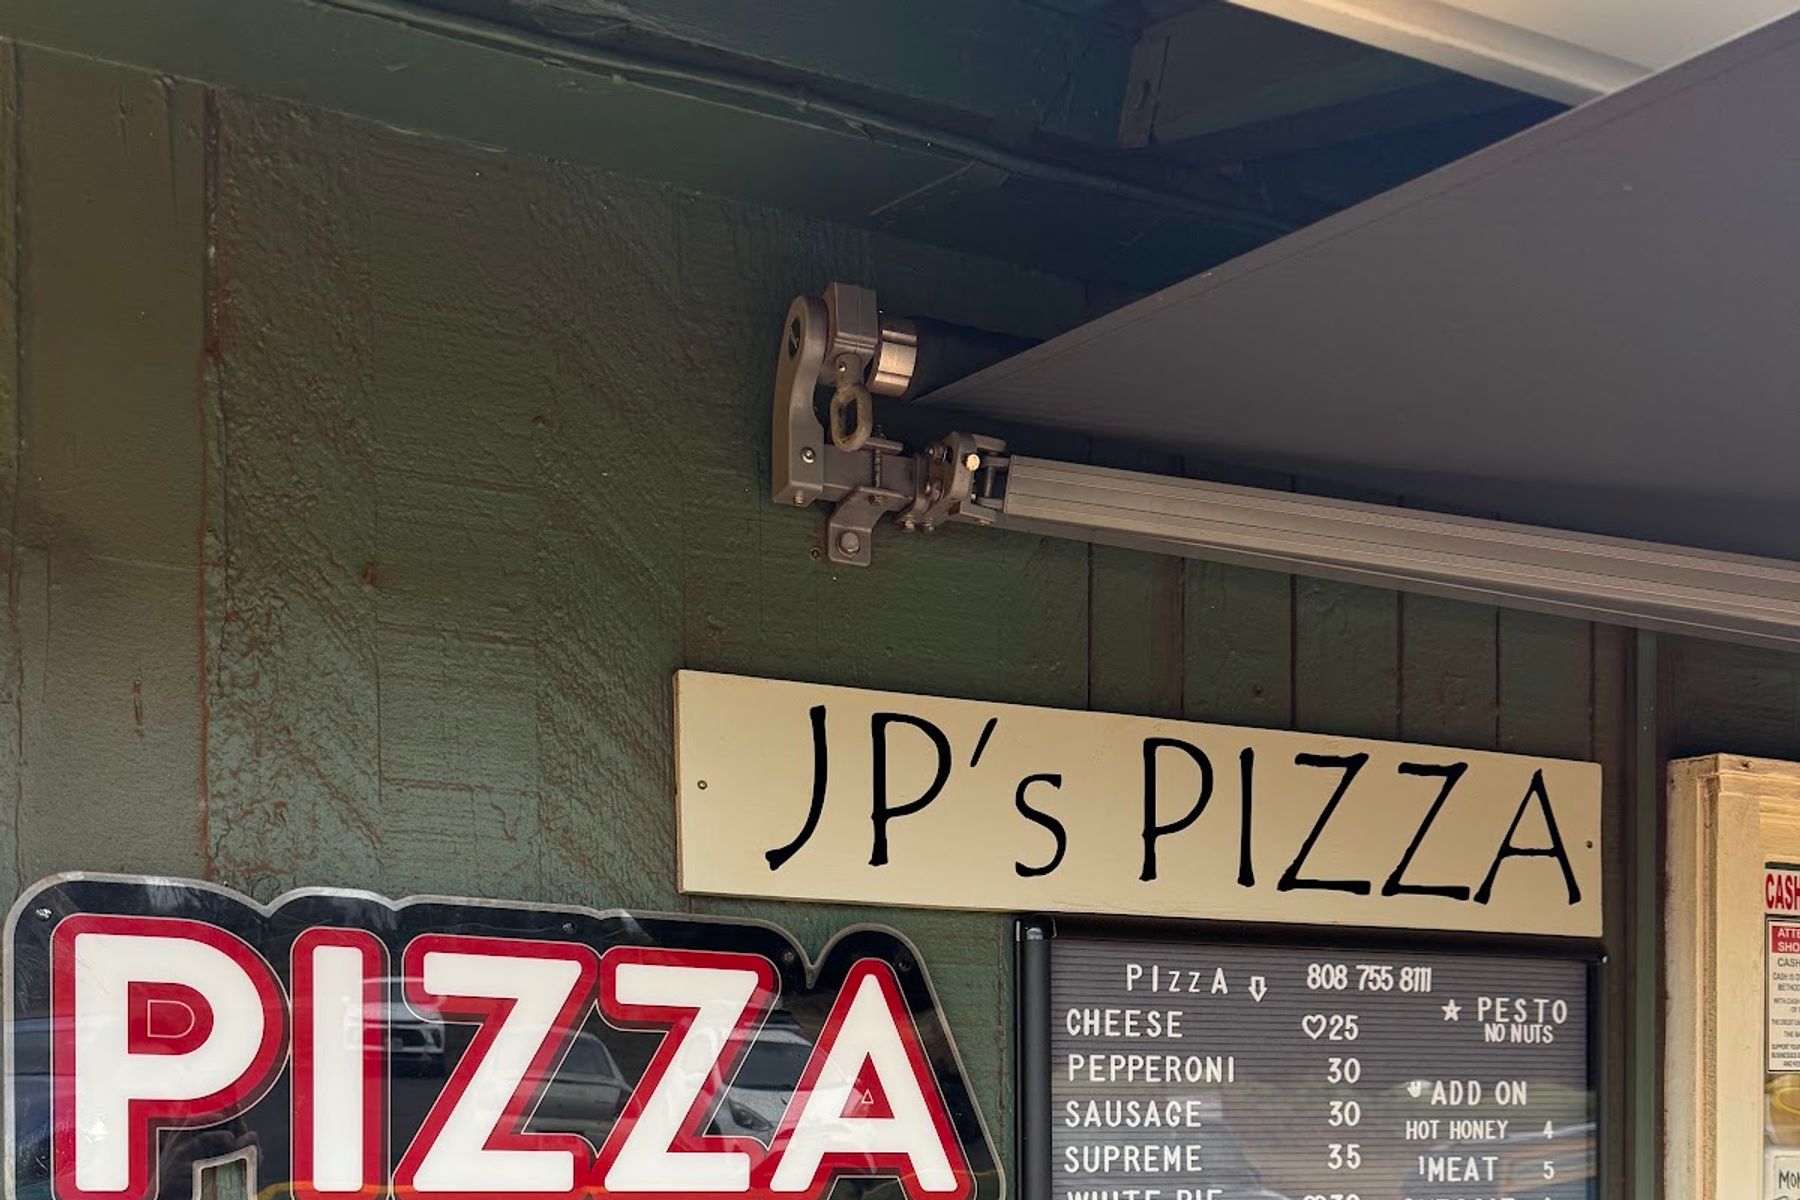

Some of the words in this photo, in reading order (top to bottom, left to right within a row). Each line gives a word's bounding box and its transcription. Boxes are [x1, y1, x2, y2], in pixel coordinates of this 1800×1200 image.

[764, 704, 1069, 879] JP's
[1138, 737, 1582, 906] PIZZA
[1306, 963, 1348, 991] 808
[1355, 964, 1395, 991] 755
[1400, 966, 1432, 993] 8111
[1066, 1008, 1184, 1039] CHEESE
[1328, 1014, 1359, 1041] 25
[1476, 997, 1568, 1025] PESTO
[1484, 1023, 1506, 1043] NO
[1510, 1024, 1554, 1044] NUTS
[1067, 1054, 1235, 1084] PEPPERONI
[1326, 1057, 1361, 1084] 30
[1430, 1079, 1482, 1106] ADD
[1494, 1080, 1527, 1106] ON
[1064, 1099, 1203, 1129] SAUSAGE
[1327, 1100, 1361, 1128] 30
[1404, 1119, 1440, 1141] HOT
[1449, 1119, 1509, 1141] HONEY
[1542, 1119, 1555, 1140] 4
[1063, 1144, 1203, 1174] SUPREME
[1326, 1143, 1362, 1170] 35
[1543, 1160, 1555, 1180] 5
